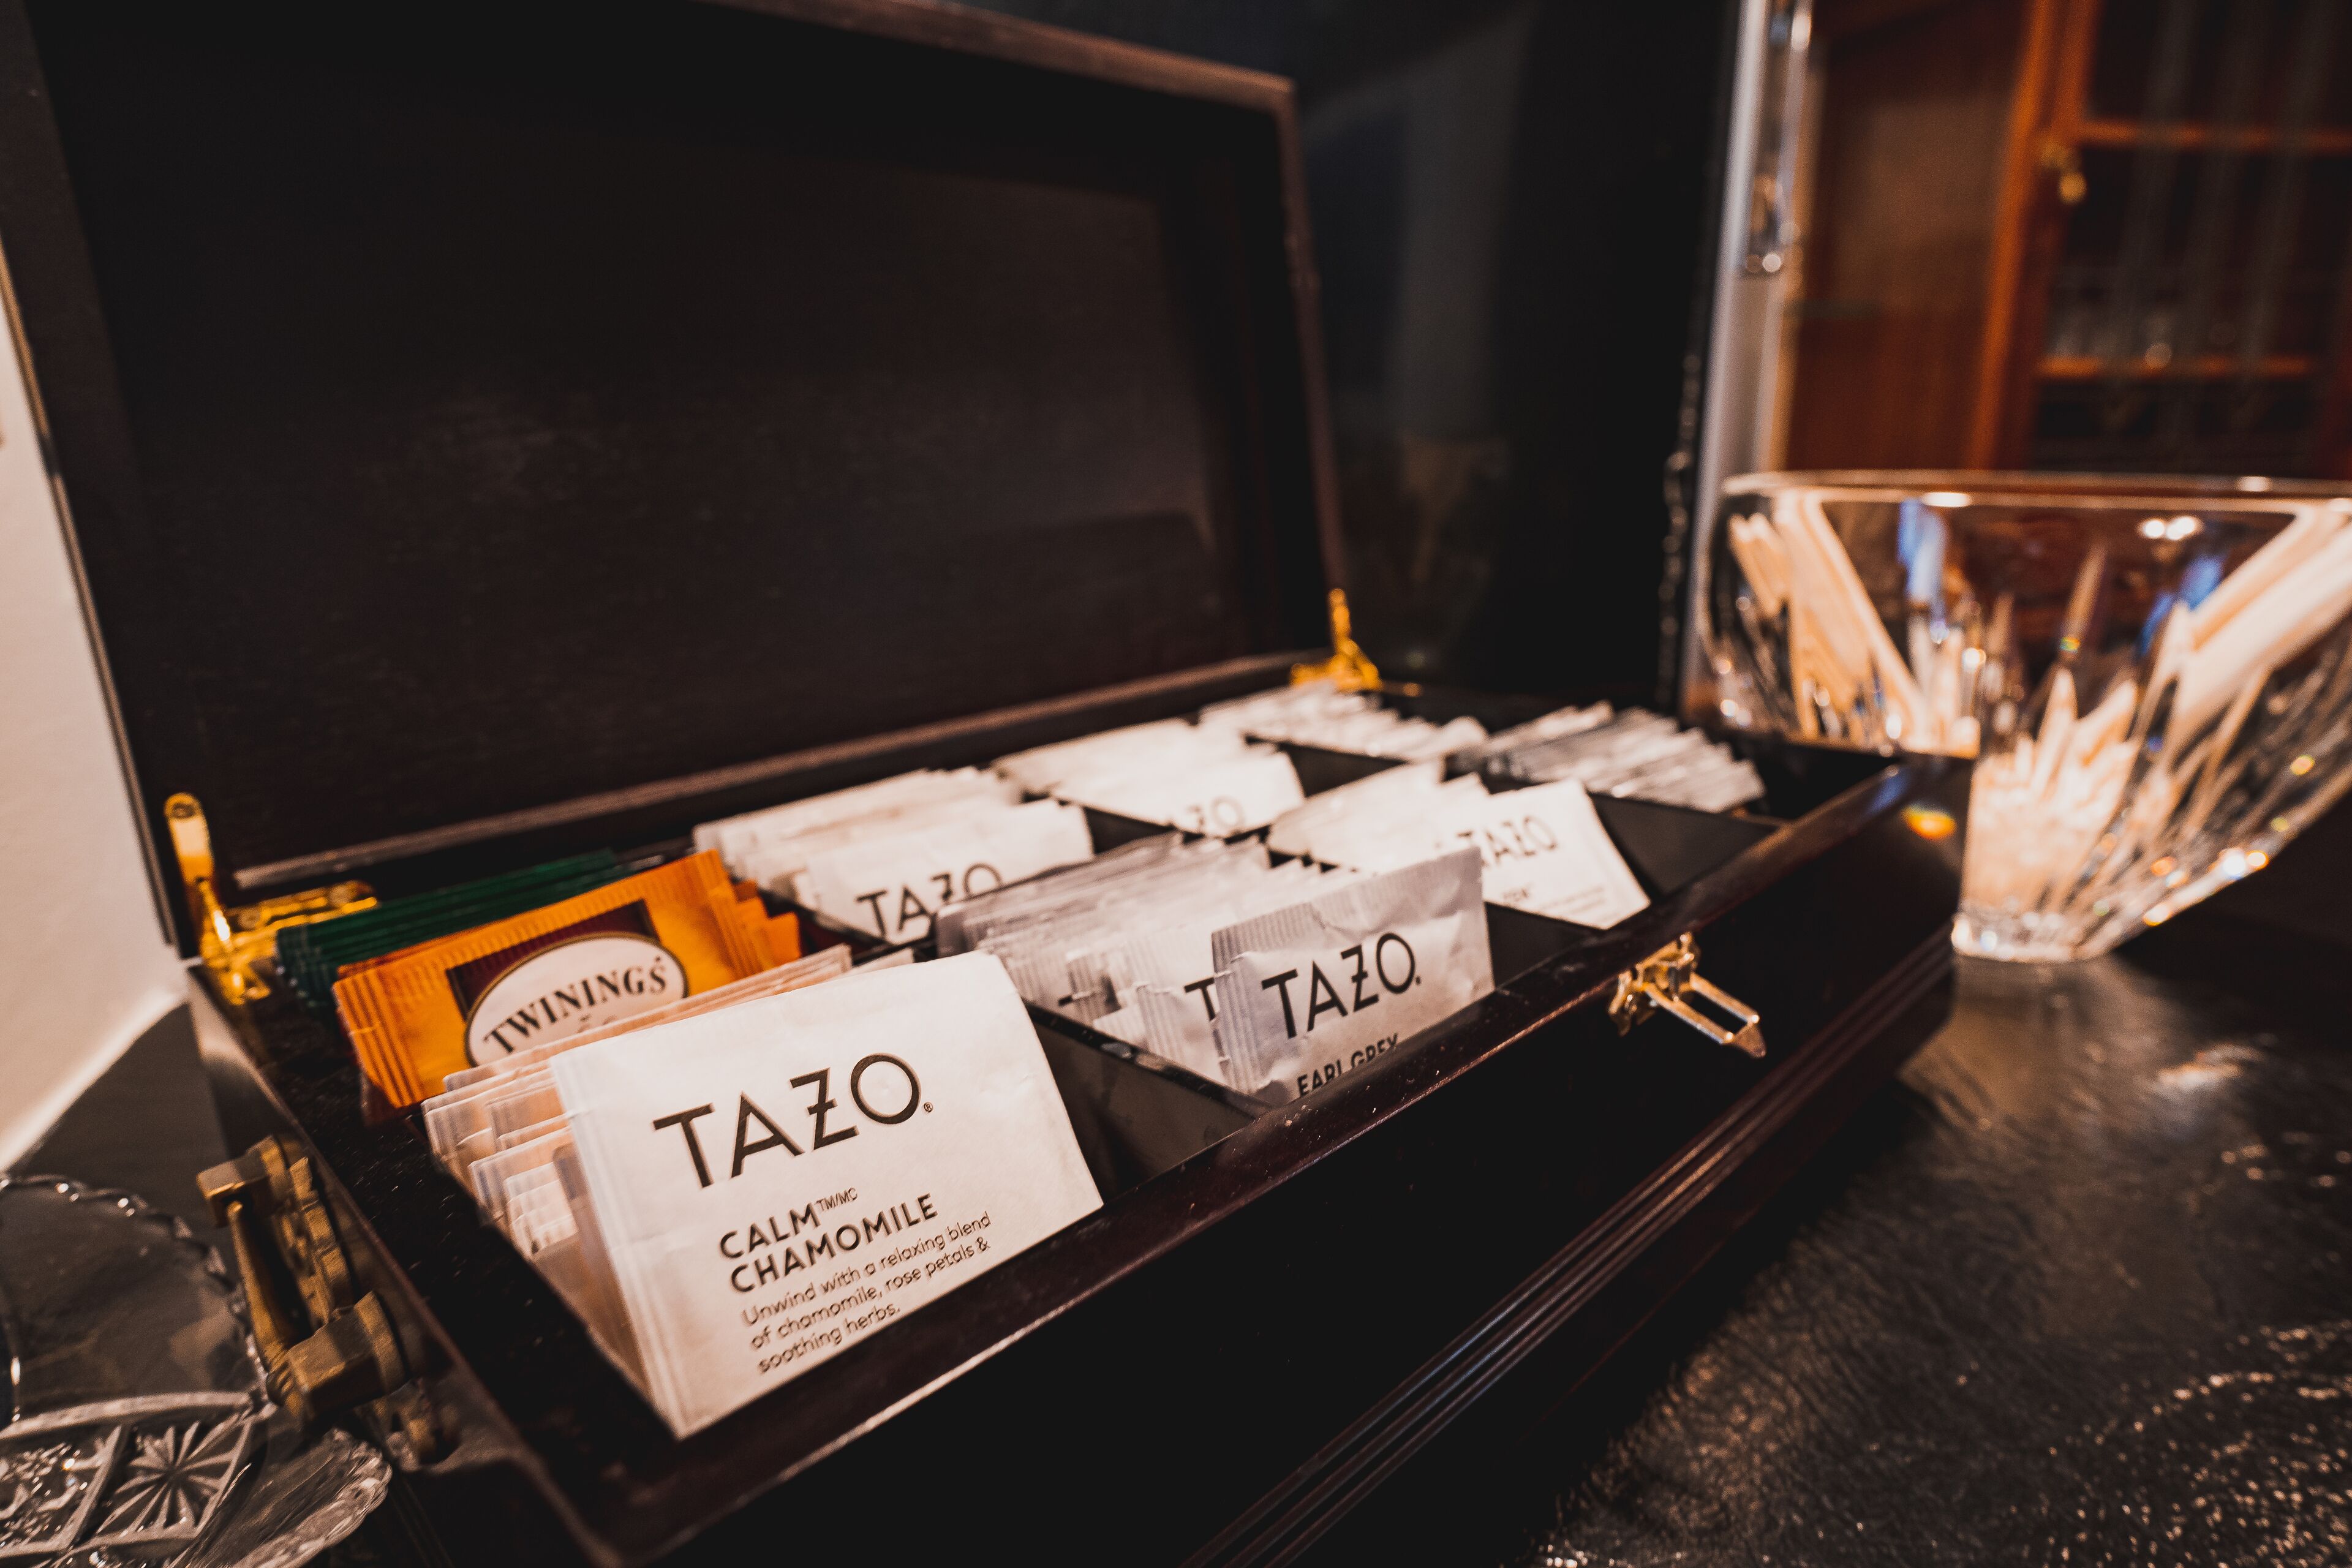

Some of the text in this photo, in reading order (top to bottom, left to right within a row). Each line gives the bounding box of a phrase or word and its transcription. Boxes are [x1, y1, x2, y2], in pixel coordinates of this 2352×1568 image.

[483, 963, 666, 1054] TWININGS
[1261, 932, 1415, 1038] TAZO
[652, 1052, 921, 1188] TAZO
[730, 1193, 938, 1292] CHAMOMILE
[741, 1210, 991, 1326] Unwind with a relaxing blend
[750, 1236, 990, 1351] of chamomile, rose petals &
[758, 1303, 900, 1375] soothing herbs.
